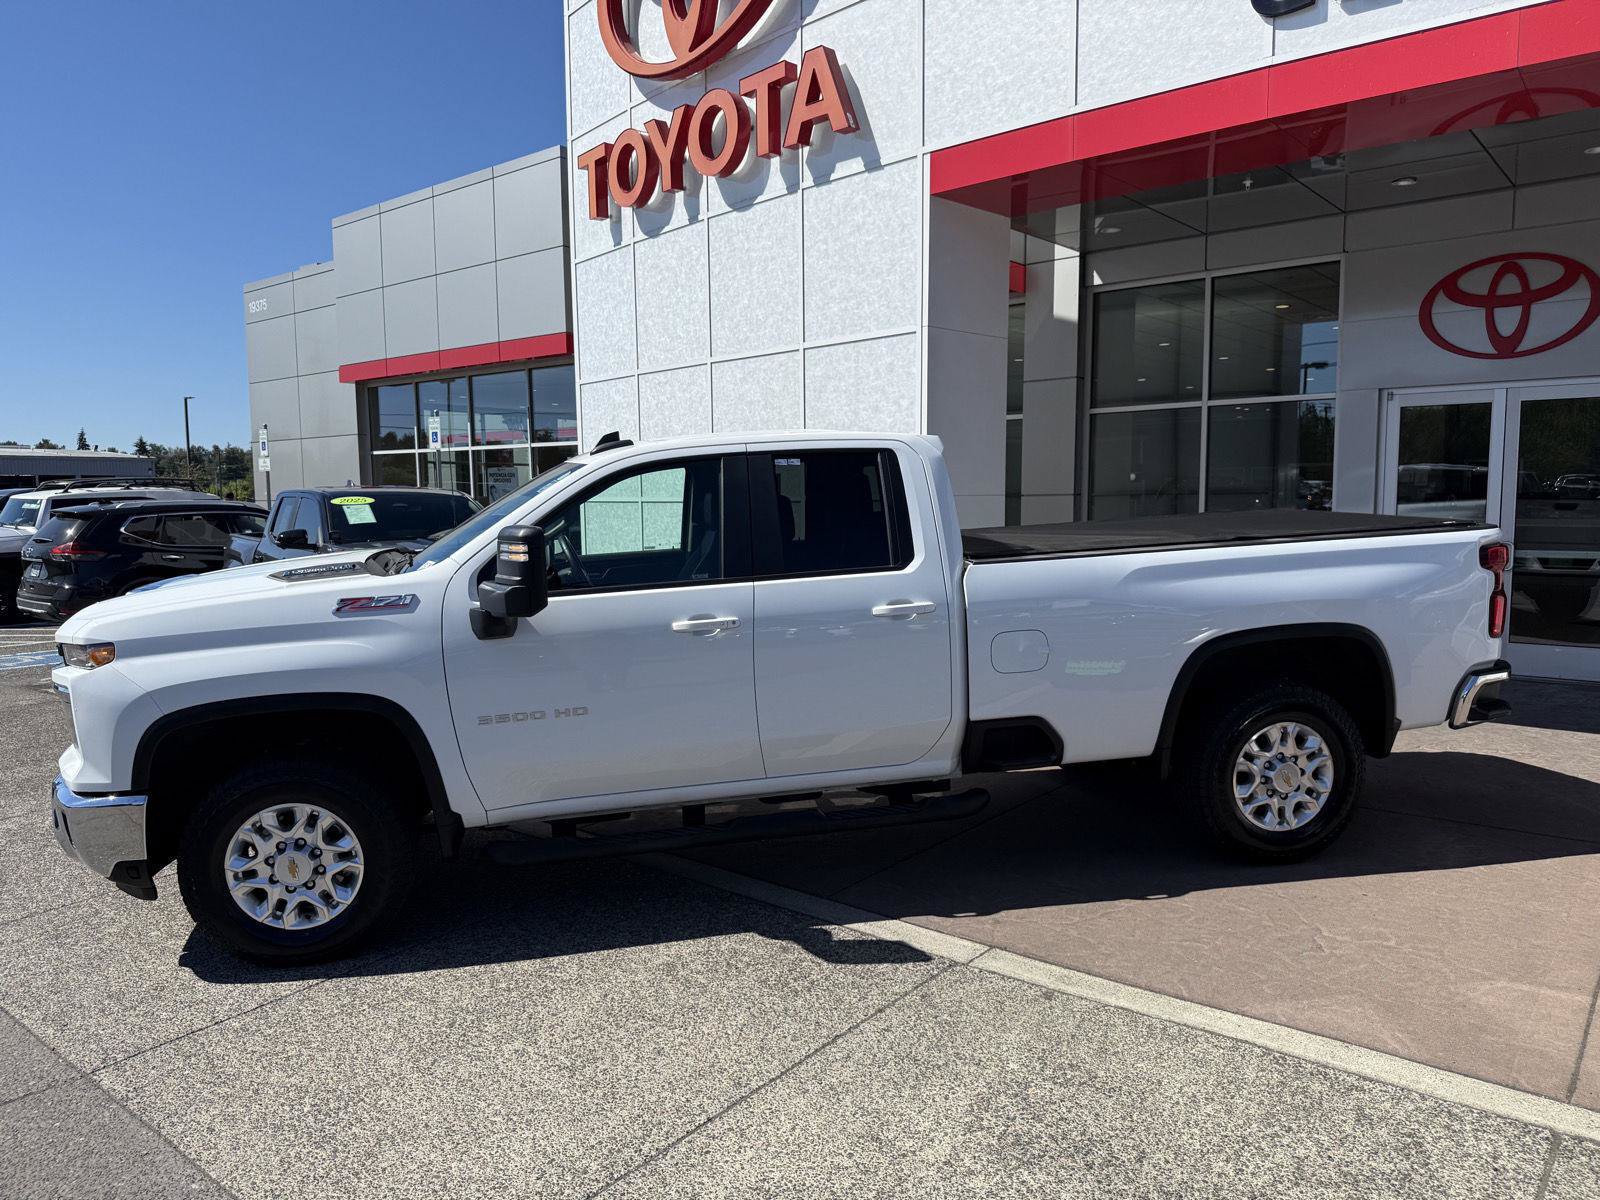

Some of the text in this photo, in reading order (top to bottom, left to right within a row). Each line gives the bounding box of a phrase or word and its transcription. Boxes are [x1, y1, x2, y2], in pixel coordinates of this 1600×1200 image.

[578, 45, 859, 220] TOYOTA
[248, 298, 268, 313] 19375
[336, 594, 414, 613] Z71
[554, 706, 588, 719] HD
